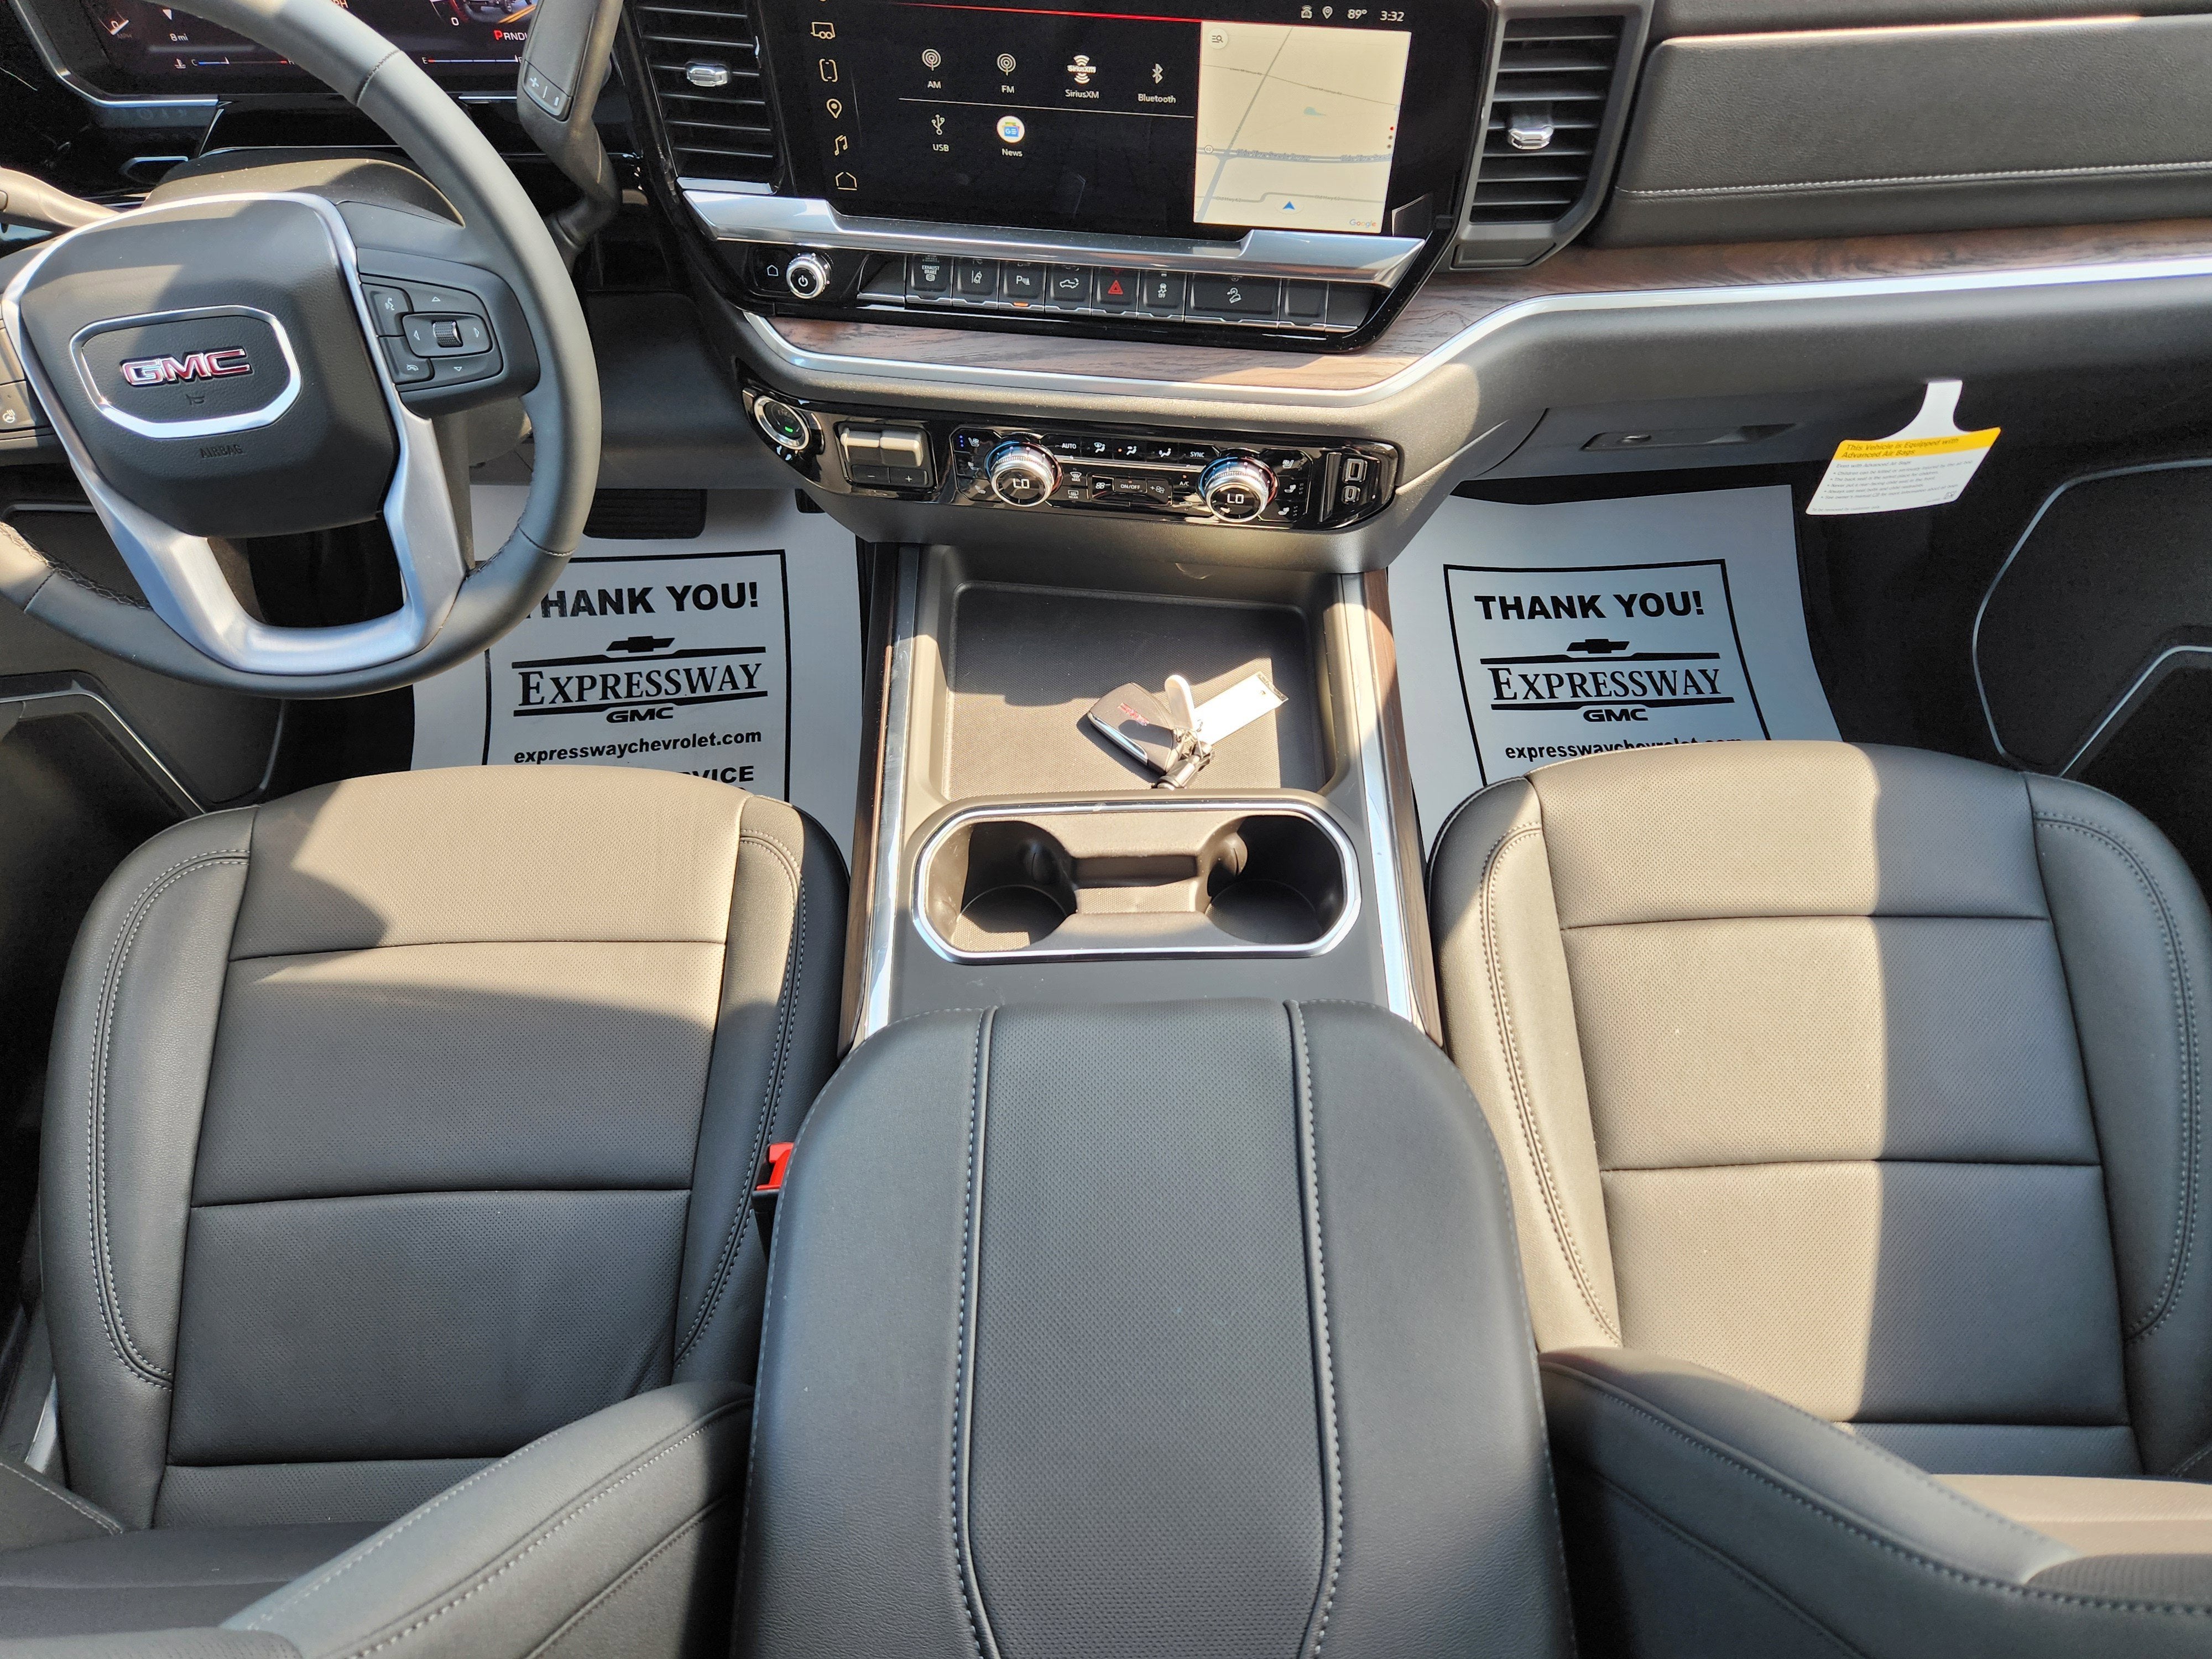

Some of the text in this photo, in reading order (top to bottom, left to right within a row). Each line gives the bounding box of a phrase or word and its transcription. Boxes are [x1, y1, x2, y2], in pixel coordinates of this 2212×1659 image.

[1347, 9, 1368, 19] 89°
[1380, 10, 1405, 22] 3:32
[170, 33, 178, 41] 8
[927, 81, 942, 89] AM
[1001, 85, 1015, 93] FM
[1065, 89, 1099, 99] SiriusXM
[1138, 93, 1176, 103] Bluetooth
[1001, 148, 1023, 157] News
[1349, 219, 1376, 228] Google
[121, 348, 252, 386] GMC
[1904, 439, 1940, 448] Equipped
[199, 444, 243, 458] AIRBAG
[1013, 478, 1030, 489] LO
[1227, 493, 1244, 504] LO
[524, 581, 759, 619] HANK YOU!
[1474, 590, 1704, 620] THANK YOU!
[518, 662, 762, 707] EXPRESSWAY
[1488, 667, 1721, 701] EXPRESSWAY
[606, 706, 674, 723] GMC
[1583, 708, 1649, 723] GMC
[514, 731, 762, 765] expresswaychevrolet.com
[1505, 737, 1743, 763] expresswaych
[677, 765, 755, 784] VICE
